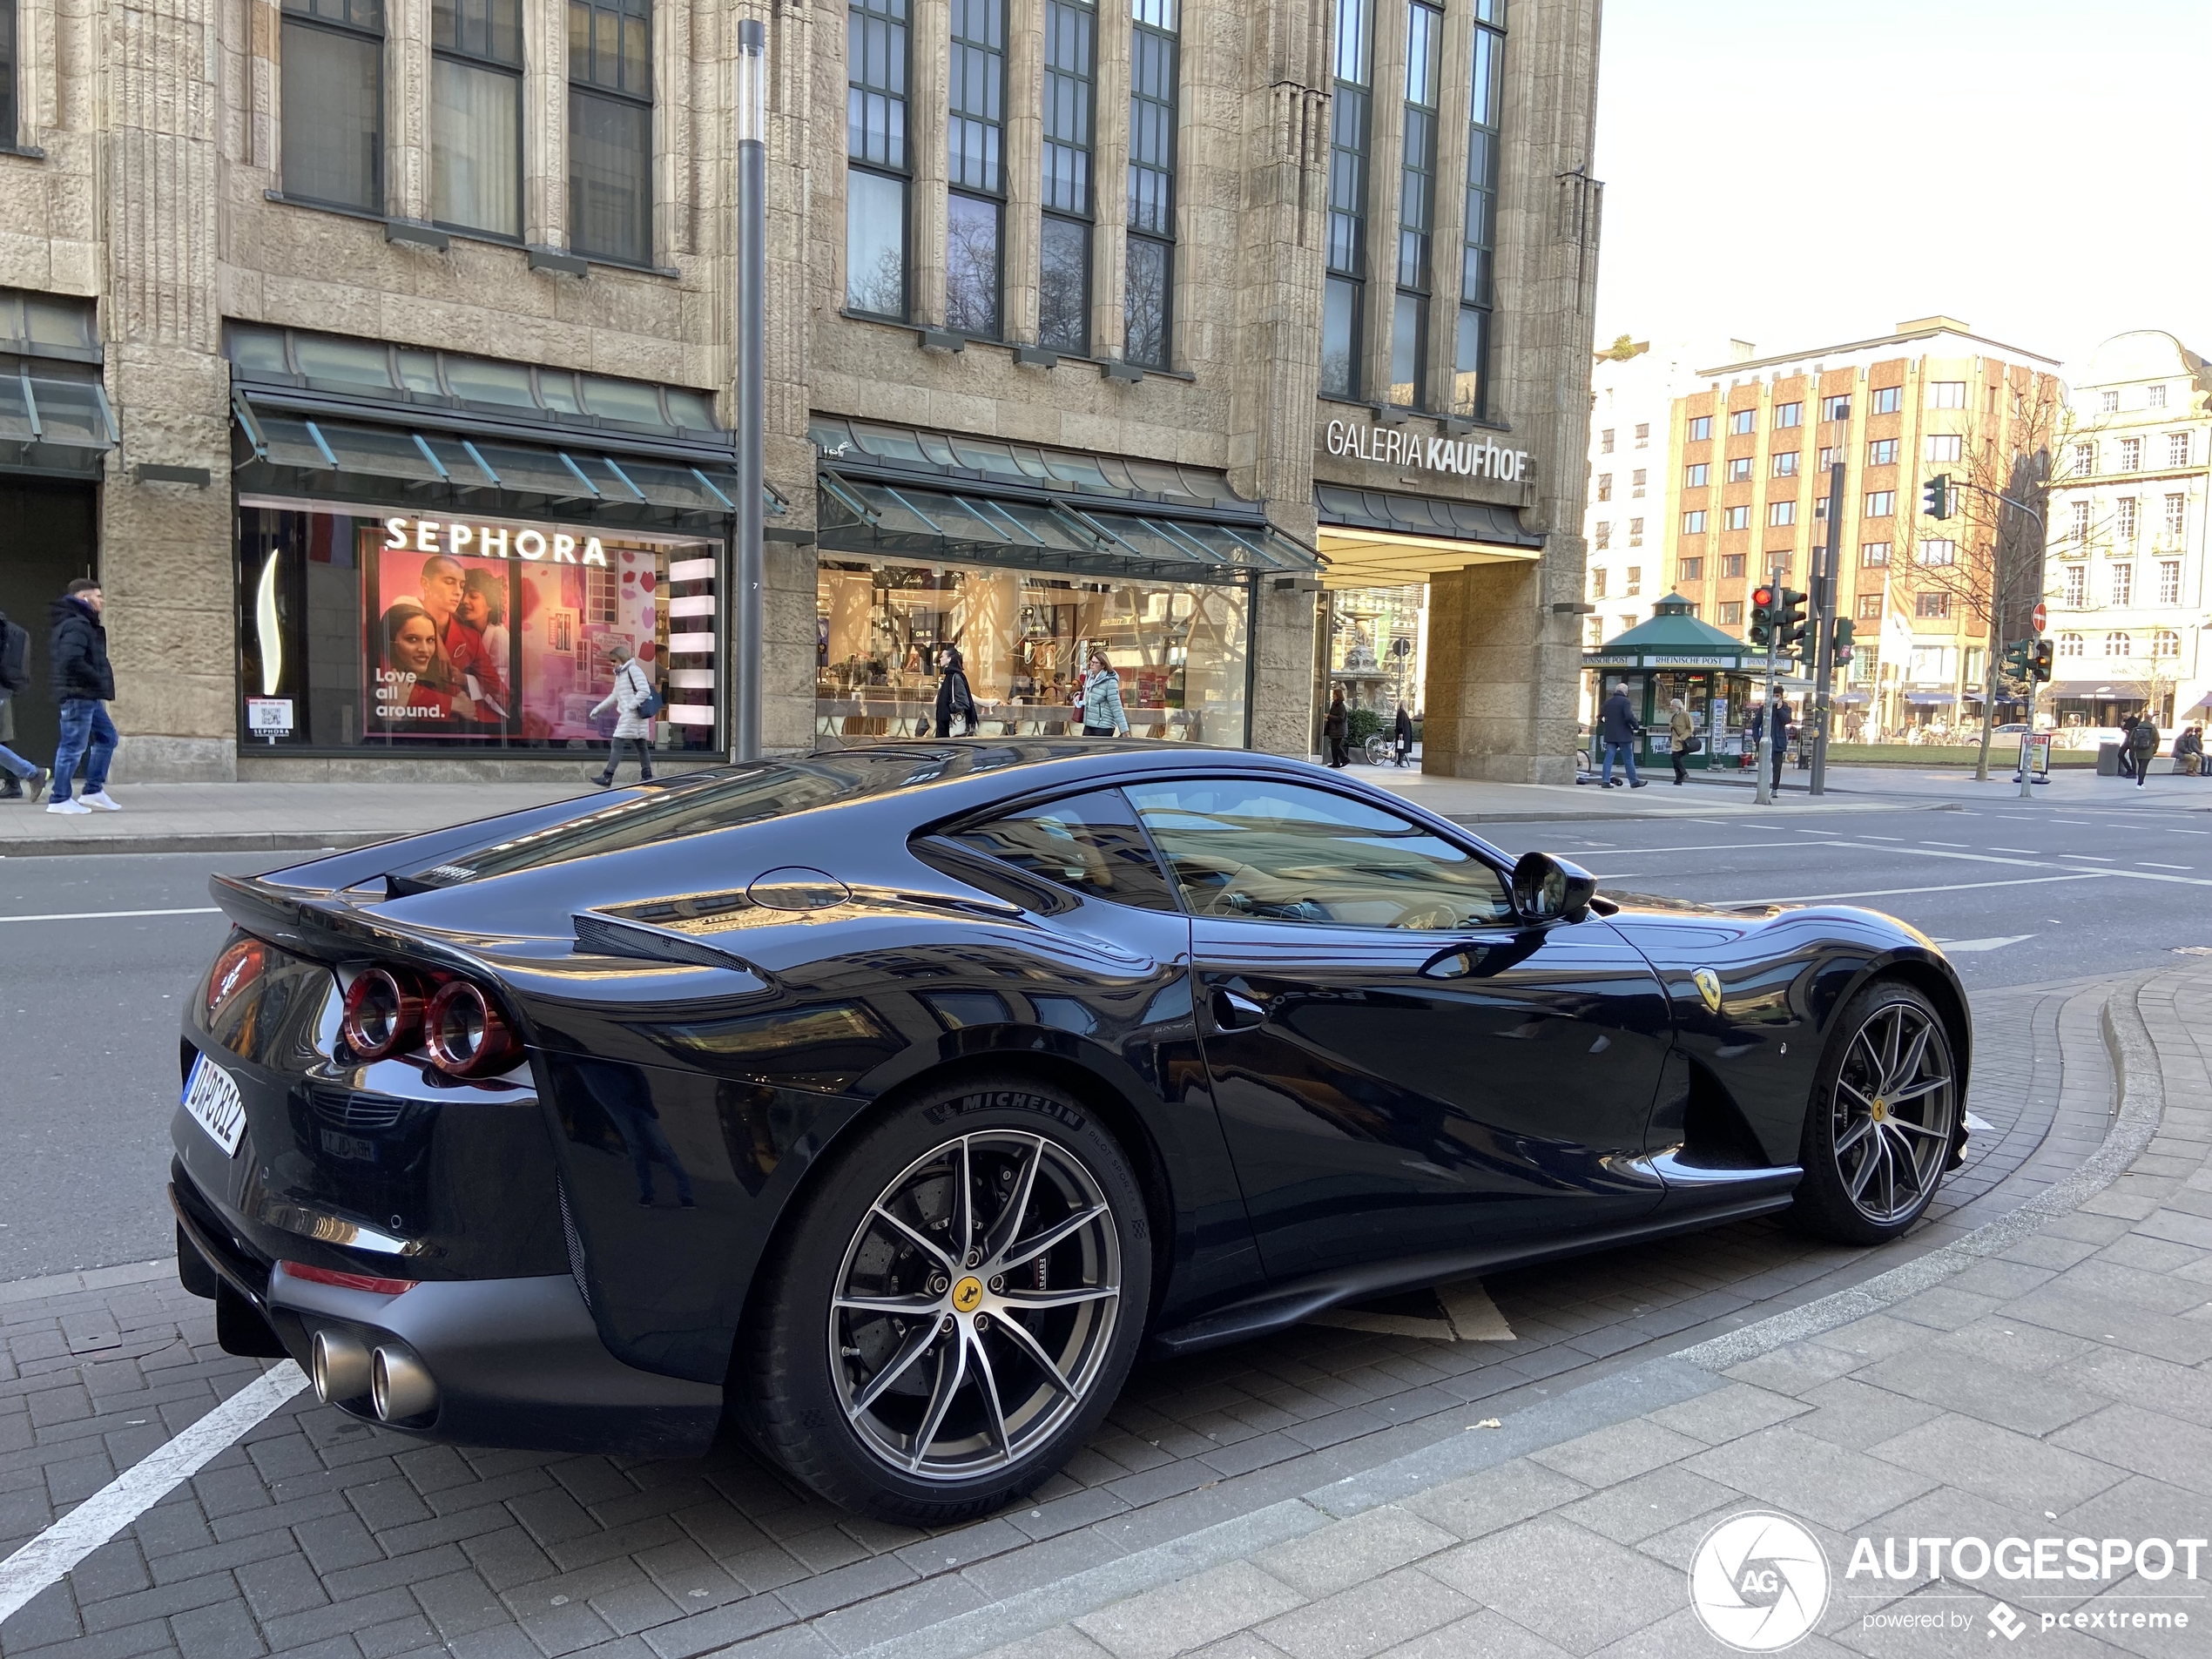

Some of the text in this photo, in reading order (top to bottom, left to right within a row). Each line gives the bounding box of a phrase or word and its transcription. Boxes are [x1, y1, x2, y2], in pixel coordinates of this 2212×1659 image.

[1326, 419, 1422, 468] GALERIA
[385, 517, 608, 567] SEPHORA
[375, 668, 417, 684] Love
[375, 685, 398, 699] all
[375, 704, 446, 718] around.
[2024, 736, 2047, 745] OSK
[213, 1082, 242, 1143] 812
[961, 1092, 1081, 1126] MICHELIN
[1088, 1130, 1112, 1157] PILOT
[1111, 1159, 1134, 1196] SPORT
